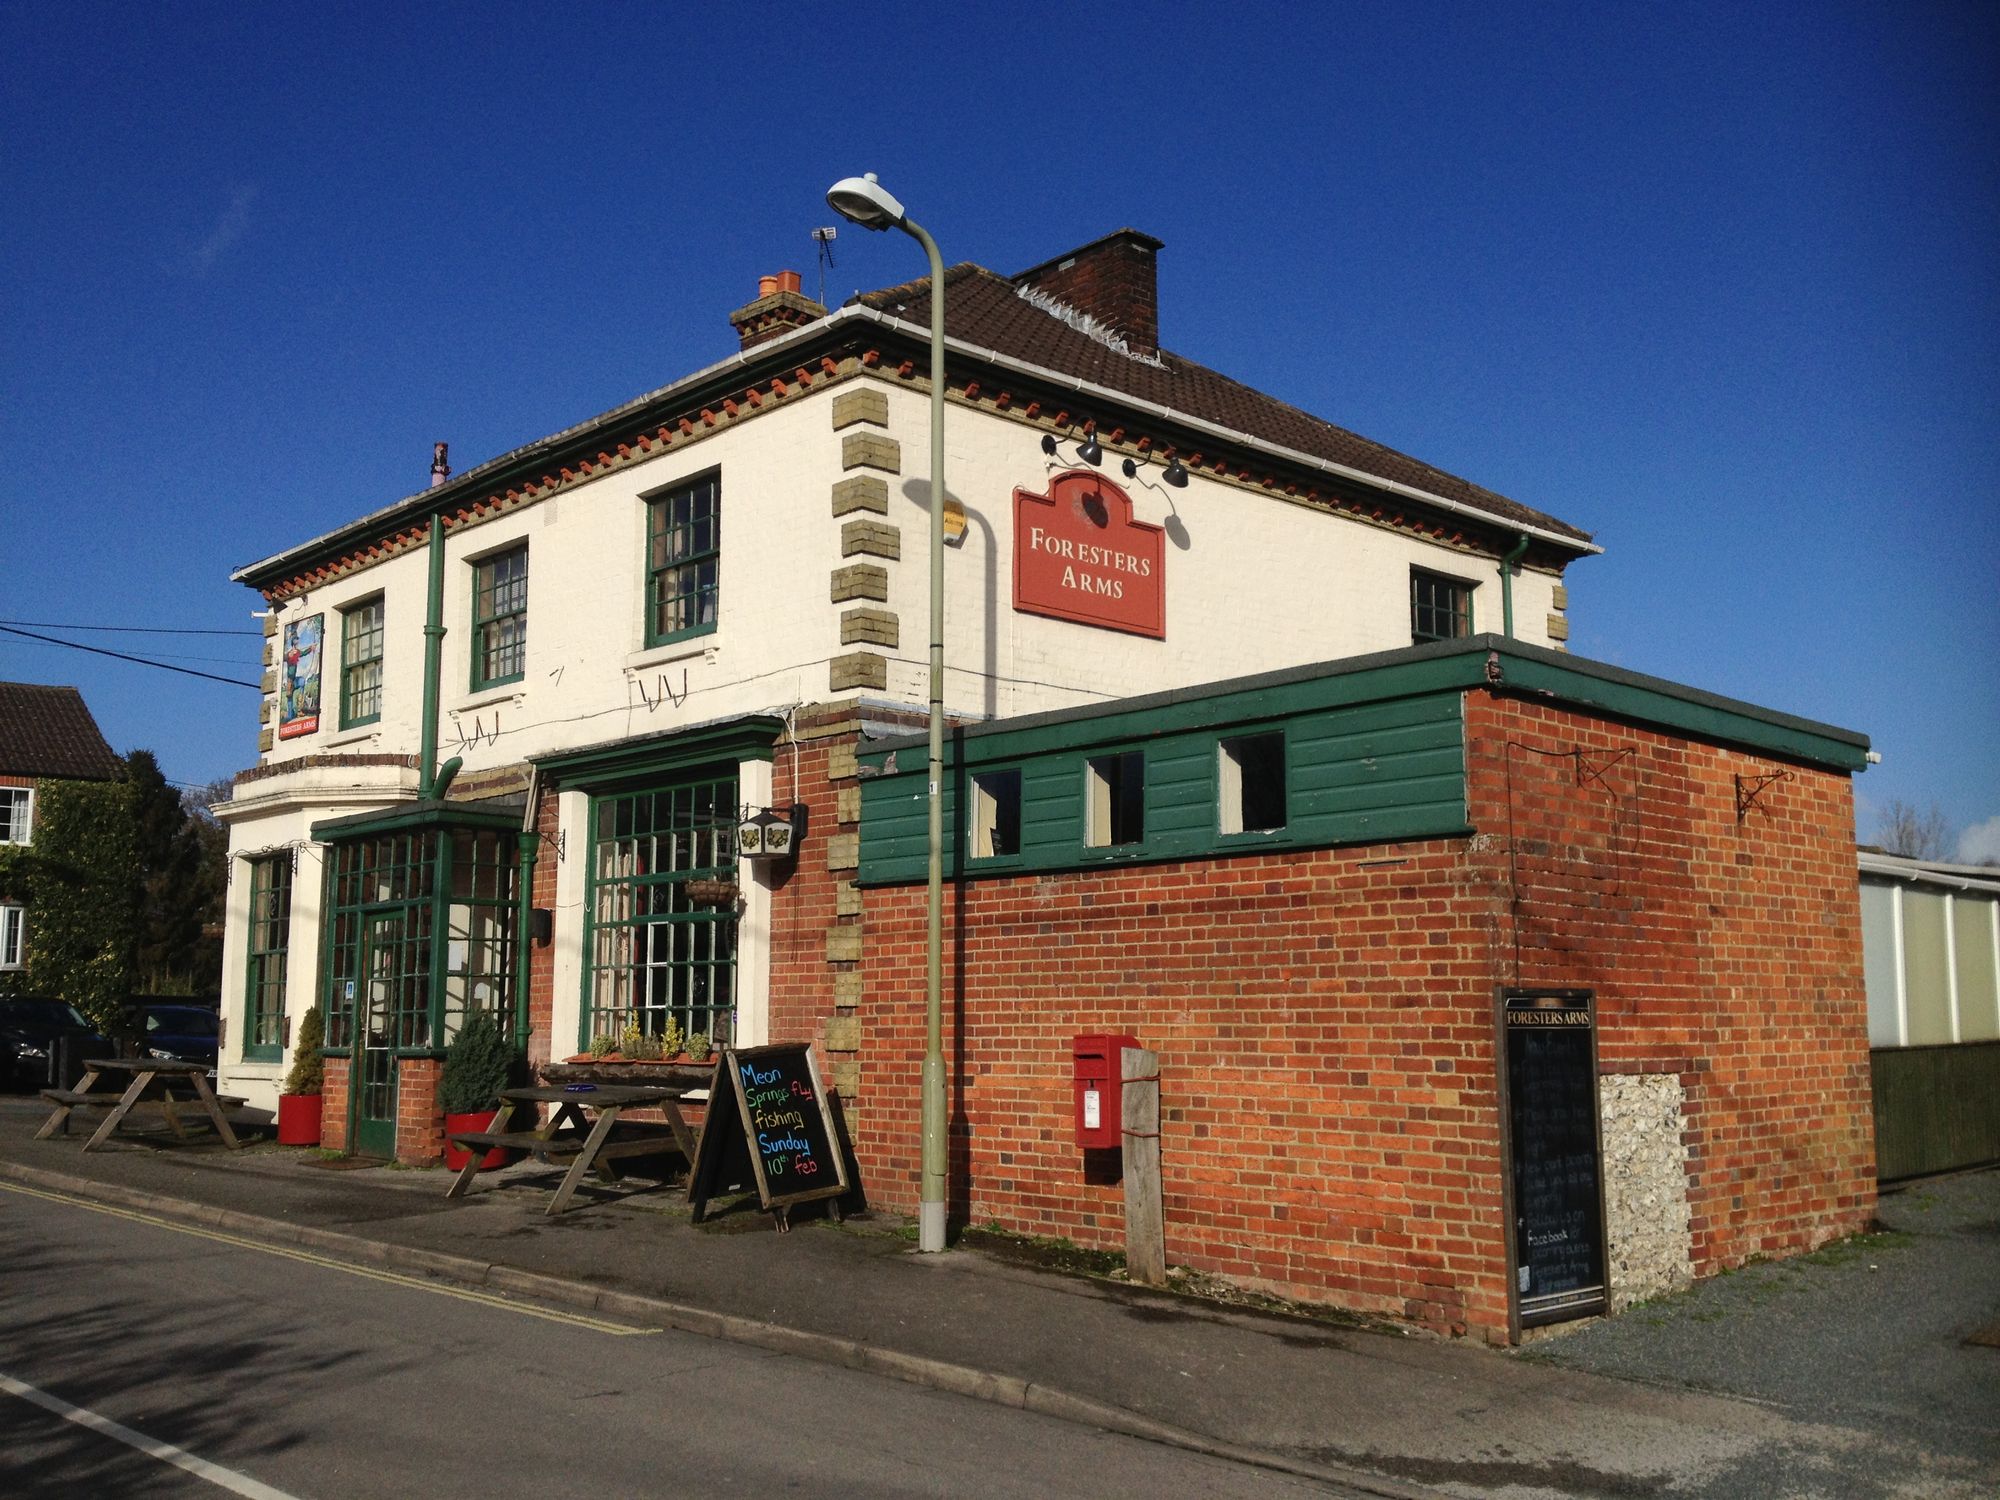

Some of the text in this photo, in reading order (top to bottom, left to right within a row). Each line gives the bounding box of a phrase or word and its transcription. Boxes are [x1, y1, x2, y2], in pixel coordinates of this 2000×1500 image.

[1030, 527, 1151, 577] FORESTERS
[1061, 566, 1124, 599] ARMS
[1507, 1011, 1590, 1025] FORESTERS ARMS
[740, 1064, 782, 1087] Meon
[745, 1088, 790, 1107] Springs
[755, 1109, 804, 1130] fishing
[759, 1131, 811, 1156] Sunday
